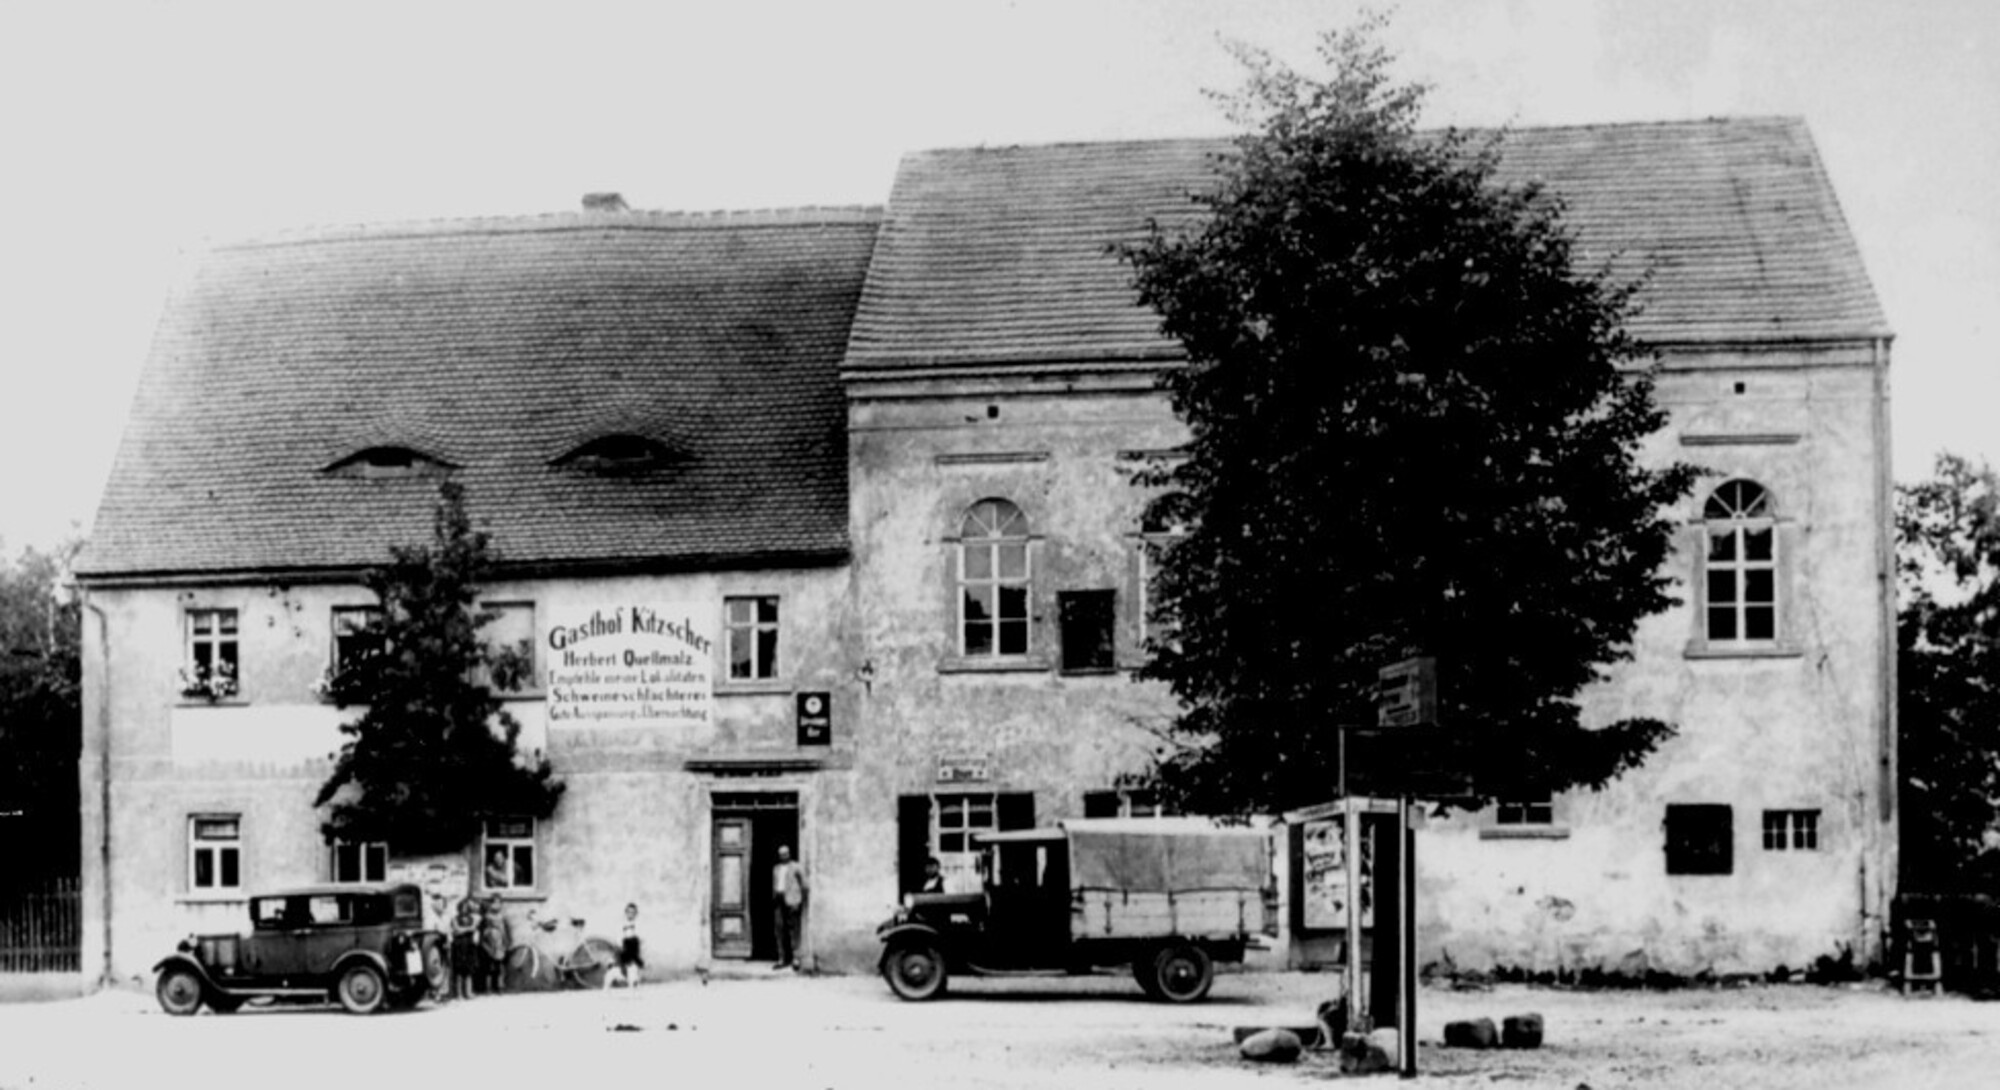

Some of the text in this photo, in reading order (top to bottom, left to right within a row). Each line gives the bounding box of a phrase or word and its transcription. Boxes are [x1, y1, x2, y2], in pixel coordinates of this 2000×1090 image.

[549, 606, 712, 655] Gasthof Kitzscher
[563, 649, 693, 667] Herbert Quellmalz
